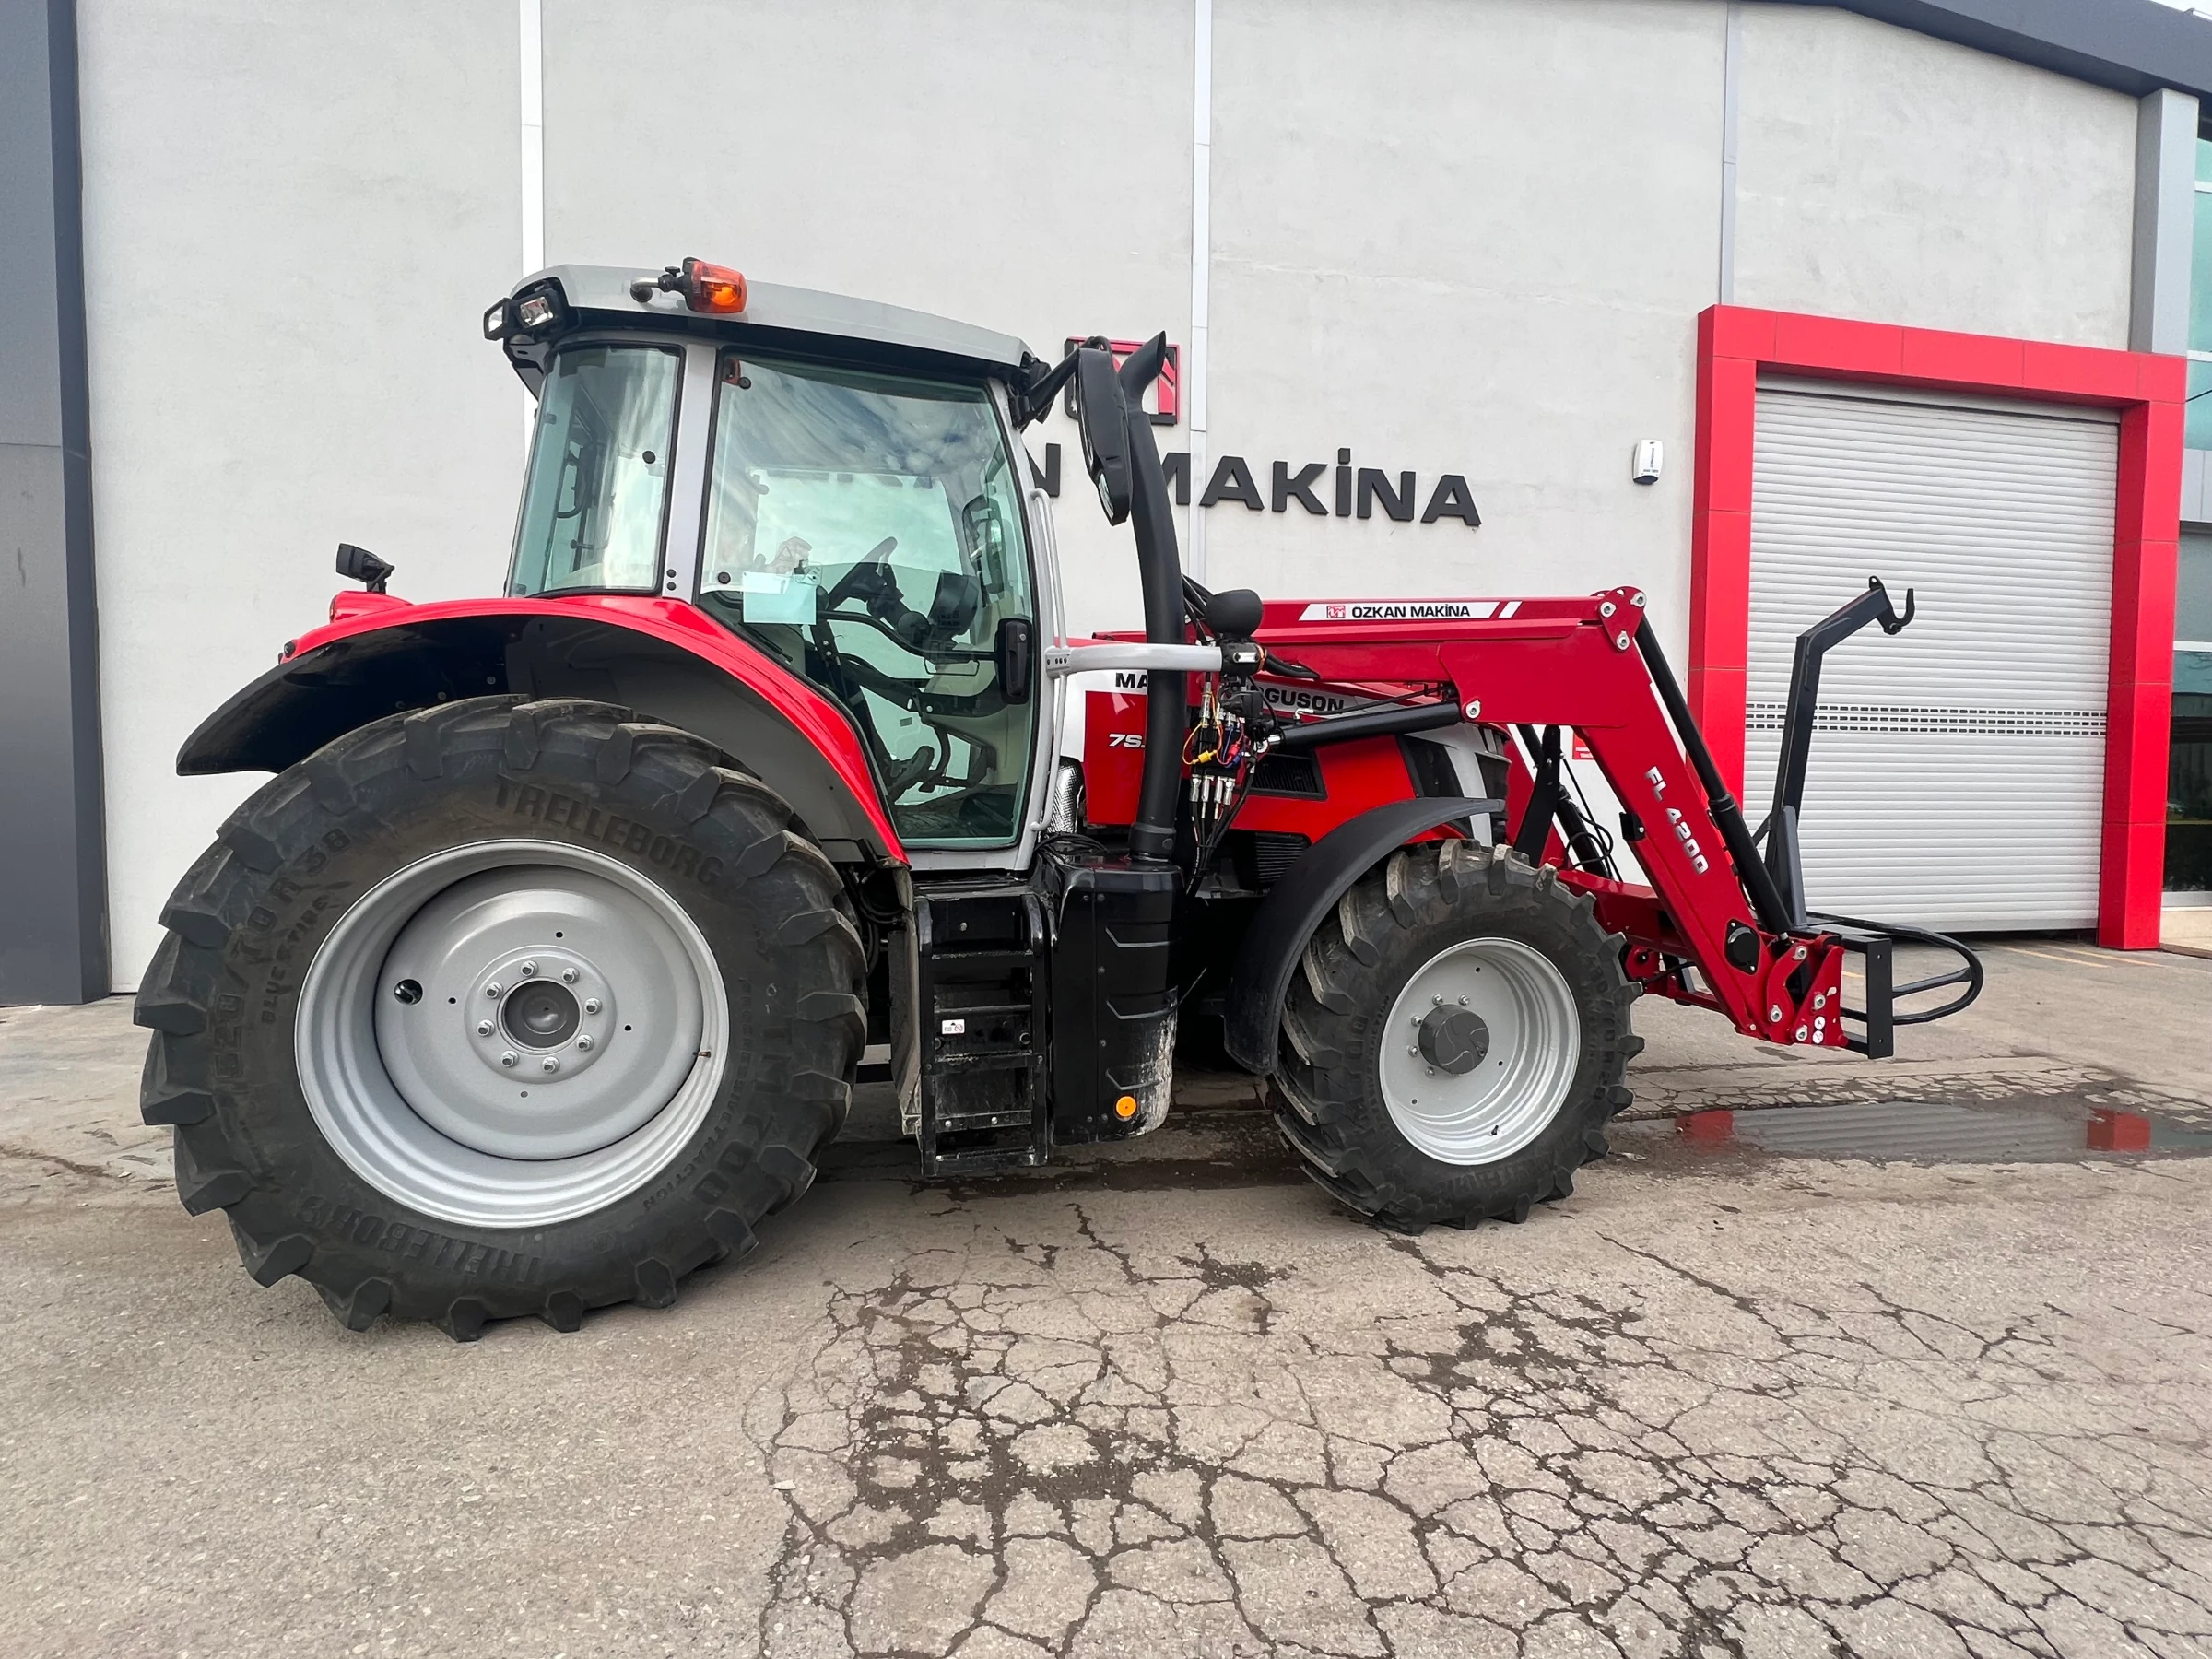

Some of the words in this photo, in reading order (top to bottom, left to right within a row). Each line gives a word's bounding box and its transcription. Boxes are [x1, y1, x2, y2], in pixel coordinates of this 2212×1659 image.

[1156, 447, 1482, 526] MAKİNA
[1351, 604, 1406, 618] ÖZKAN
[1410, 603, 1471, 618] MAKİNA
[1251, 683, 1344, 712] GUSON
[1109, 733, 1146, 748] 7S.
[495, 772, 725, 886] TRELLEBORG
[1644, 766, 1667, 802] FL
[1665, 807, 1710, 875] 4200
[293, 1193, 542, 1287] TRELLEBORG
